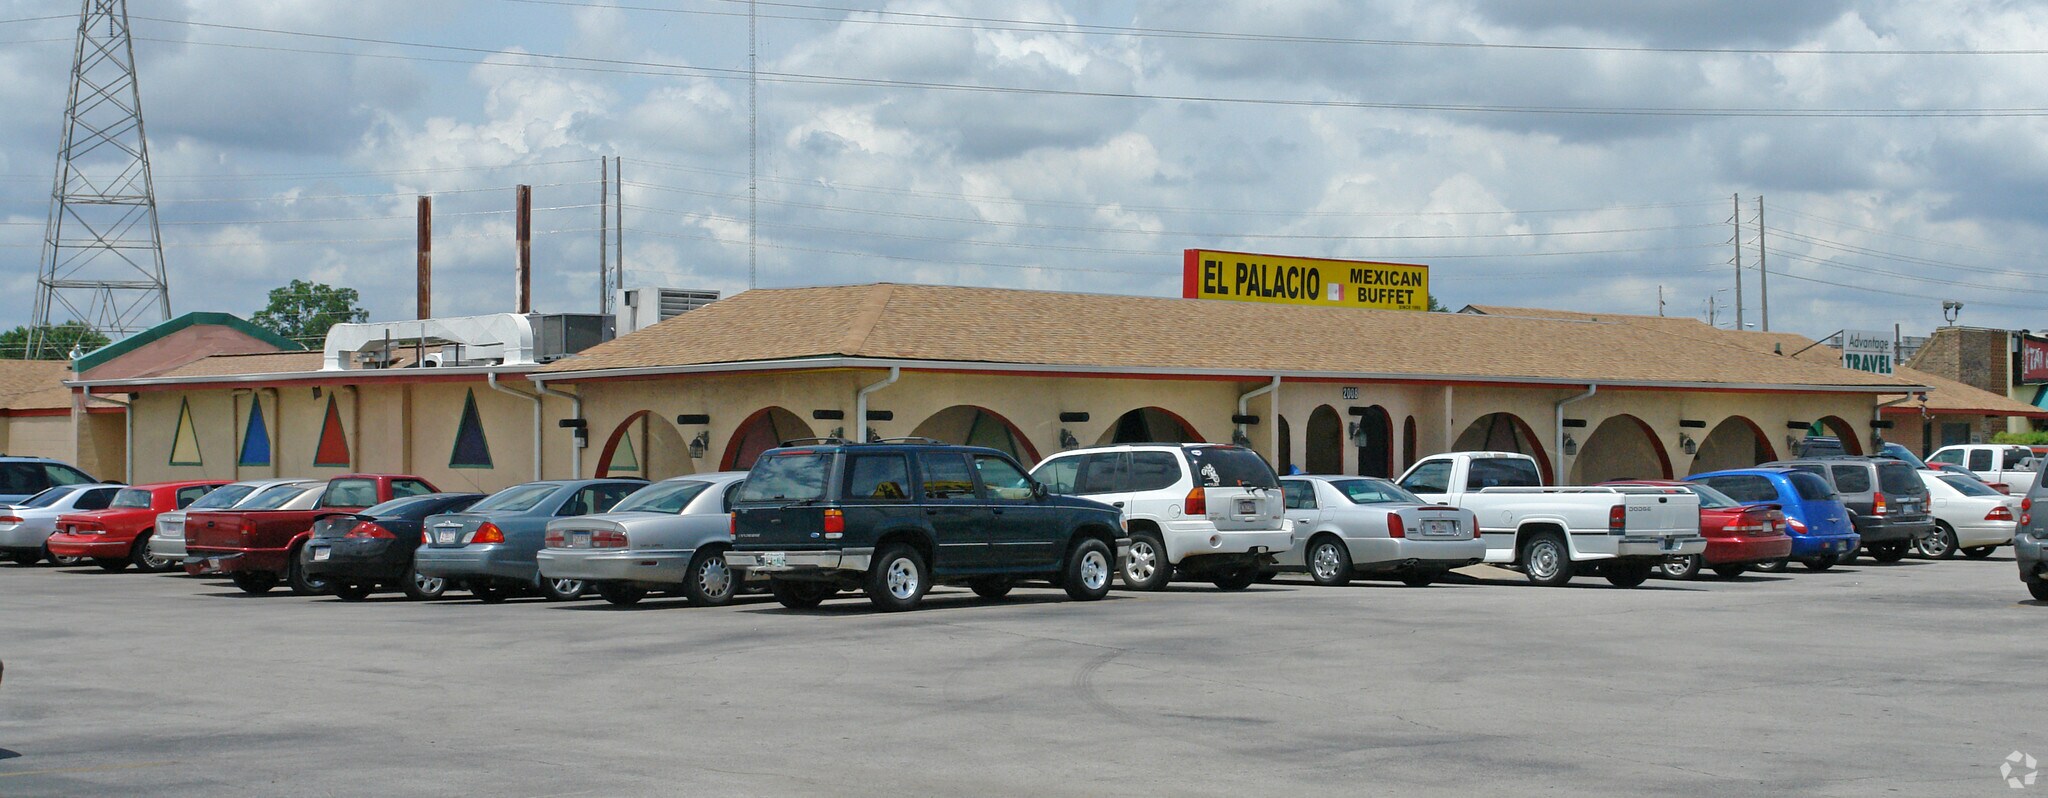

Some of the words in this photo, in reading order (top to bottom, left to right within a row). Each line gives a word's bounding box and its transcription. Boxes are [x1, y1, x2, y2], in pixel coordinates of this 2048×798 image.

[1204, 260, 1229, 294] EL
[1236, 262, 1320, 300] PALACIO
[1350, 268, 1422, 287] MEXICAN
[1358, 287, 1414, 304] BUFFET
[1849, 332, 1889, 353] Advantage
[1845, 353, 1892, 374] TRAVEL
